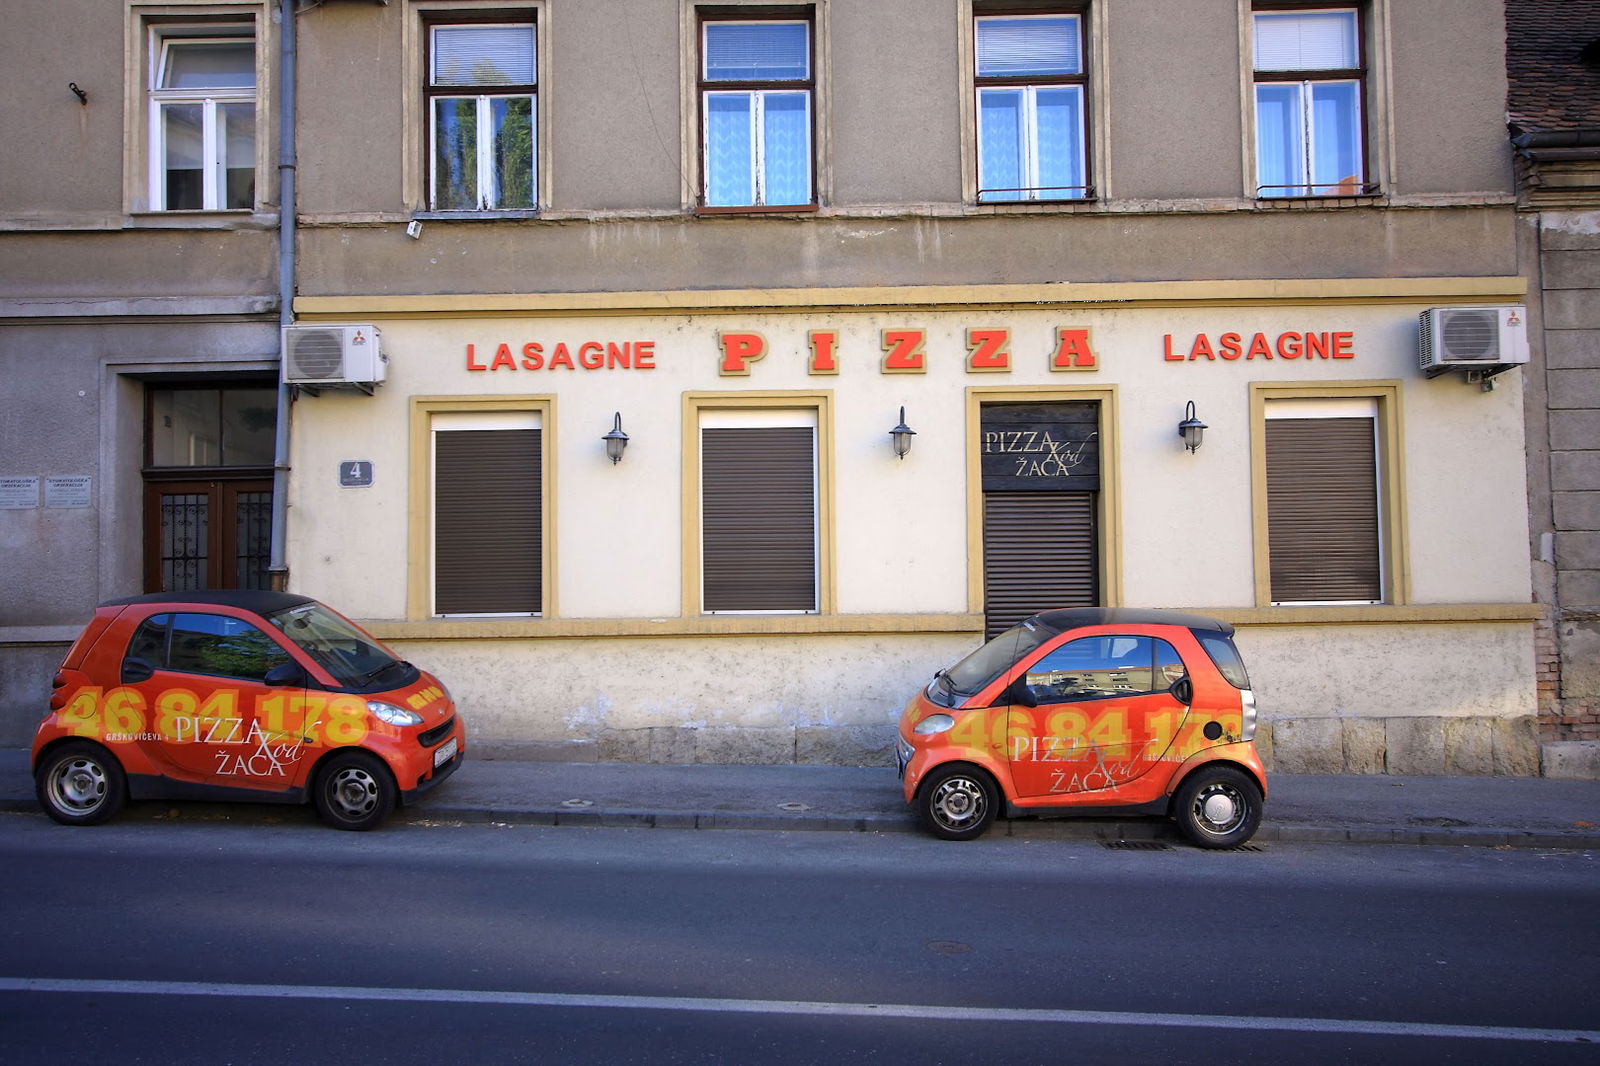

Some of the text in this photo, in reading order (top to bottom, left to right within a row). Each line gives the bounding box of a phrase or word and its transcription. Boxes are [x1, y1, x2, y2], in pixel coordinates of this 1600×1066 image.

[466, 326, 1355, 376] LASAGNE PIZZA LASAGNE
[985, 431, 1056, 453] PIZZA
[350, 462, 361, 478] 4
[1015, 456, 1070, 476] ŽACA
[58, 687, 146, 742] 46
[155, 689, 240, 743] 84
[258, 690, 369, 748] 178
[175, 716, 263, 744] PIZZA
[948, 706, 1034, 763] 46
[1046, 707, 1130, 762] 84
[1013, 736, 1105, 762] PIZZA
[214, 750, 286, 776] ŽACA
